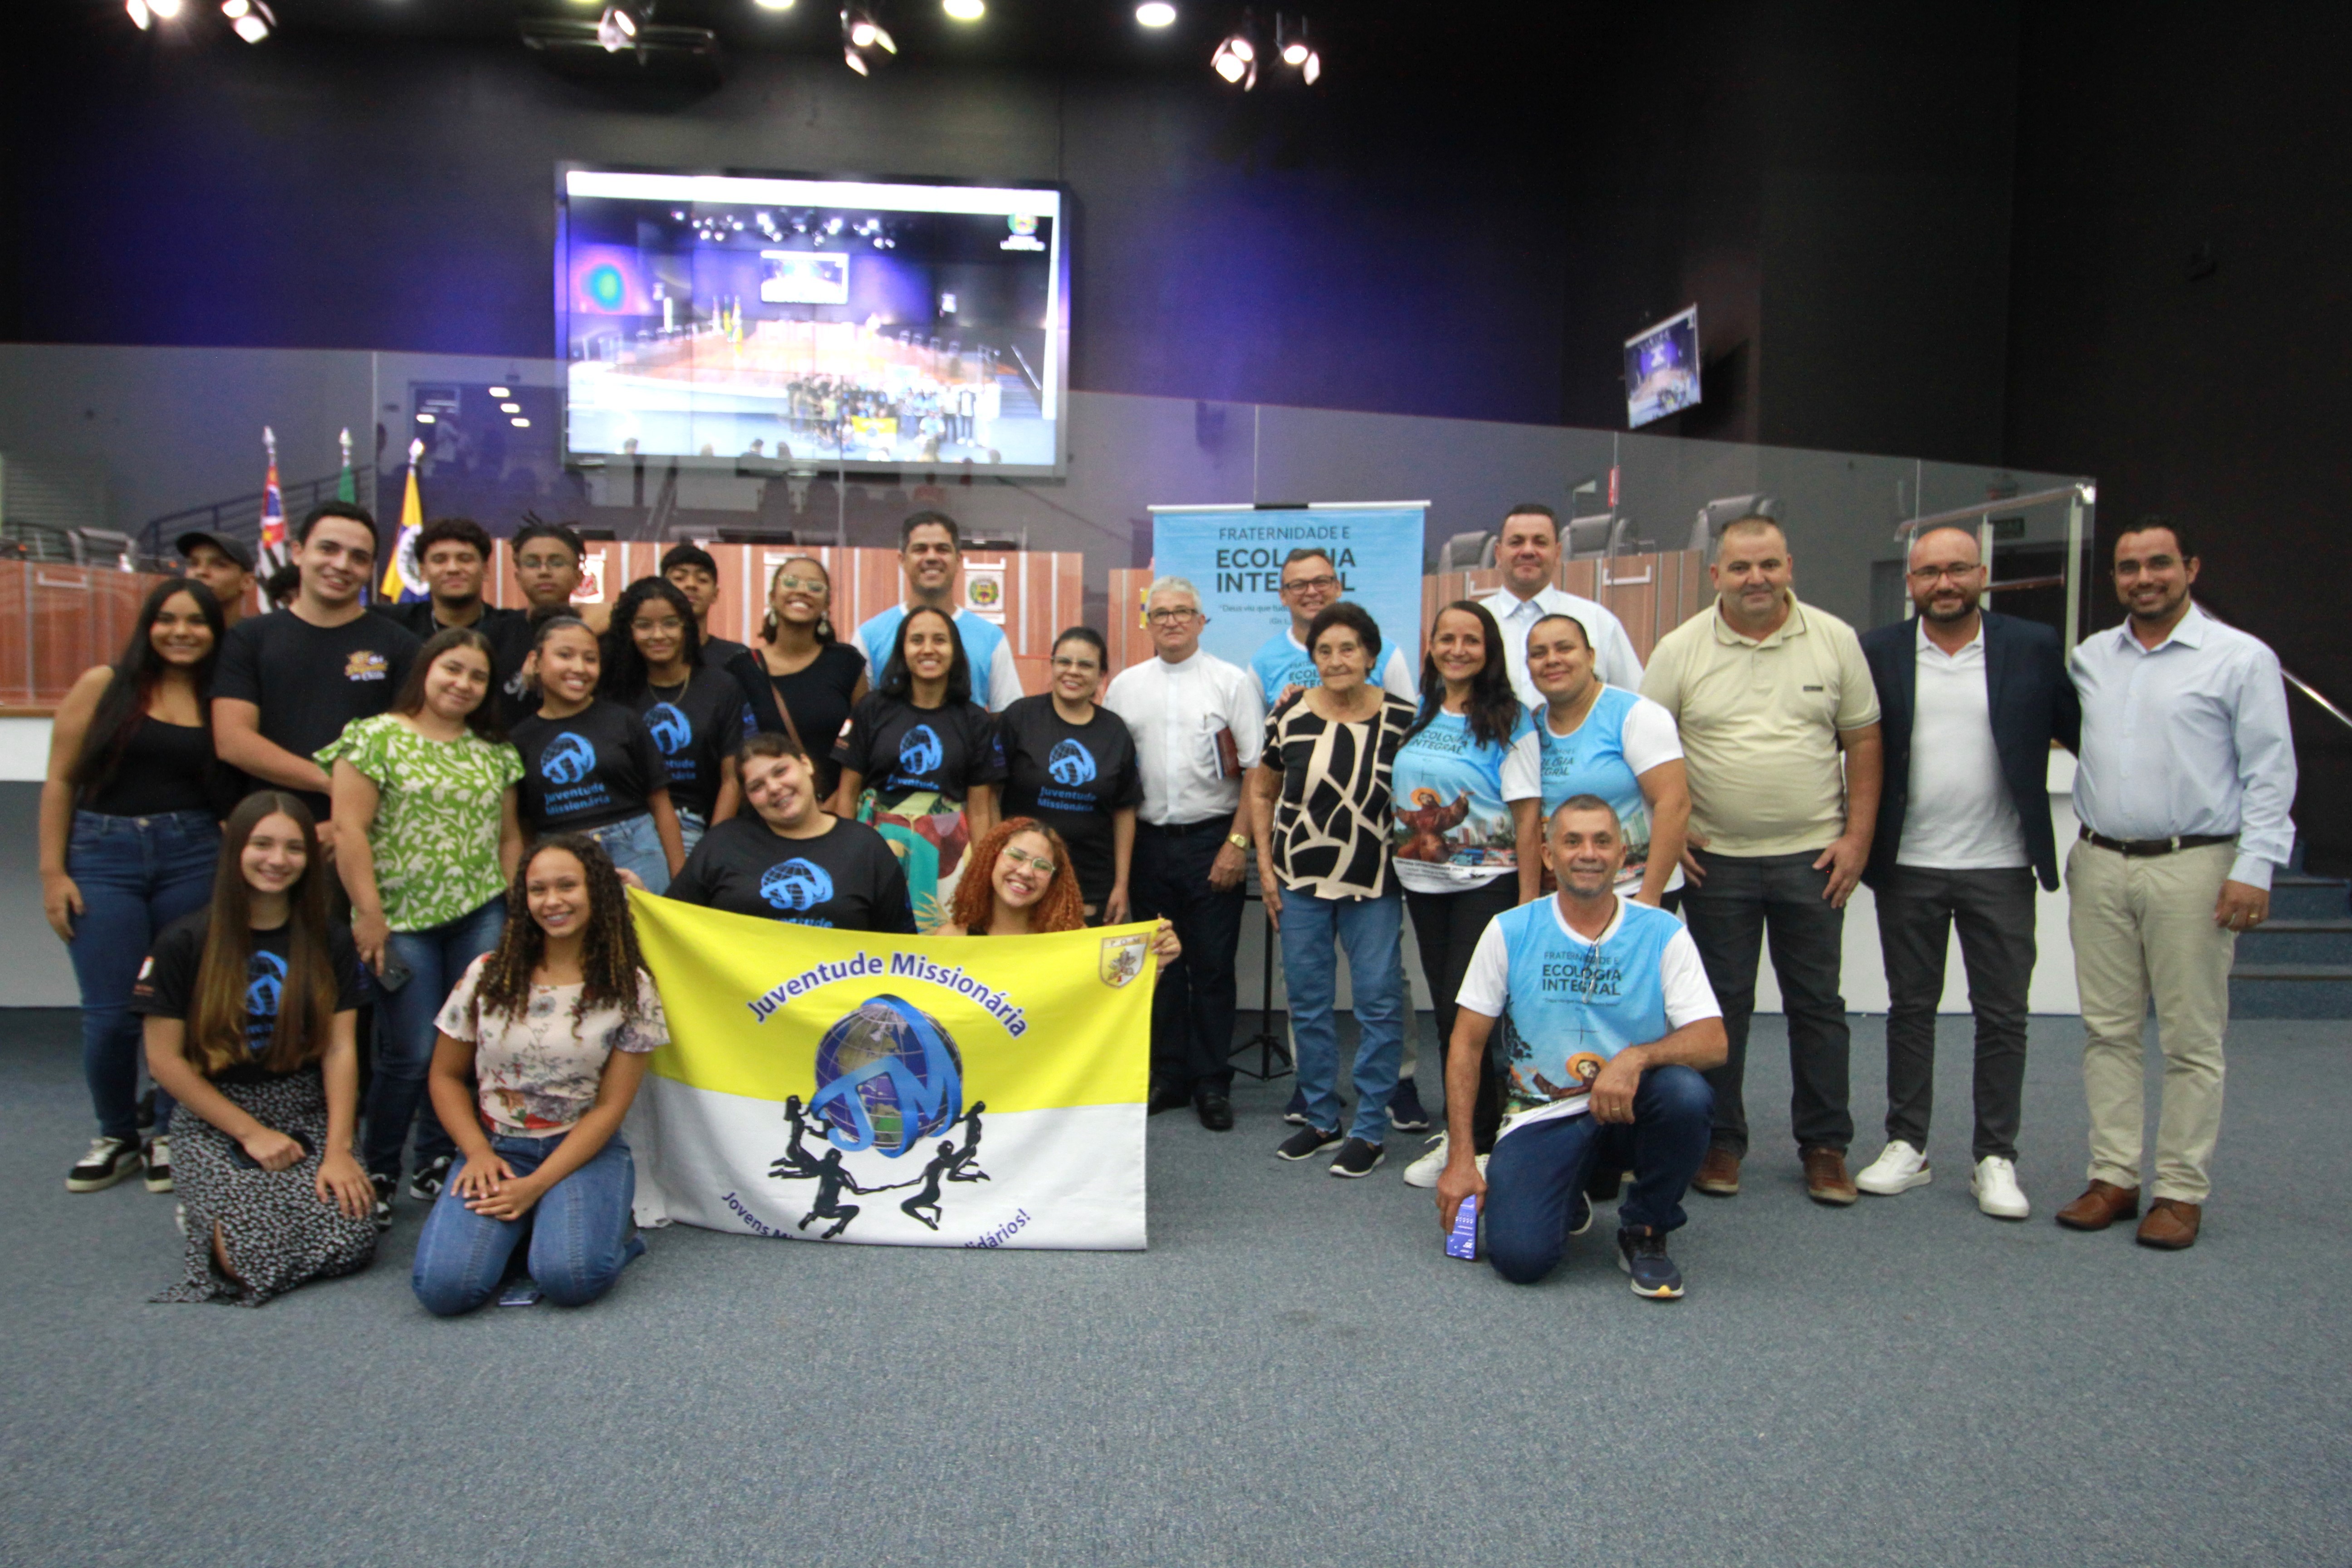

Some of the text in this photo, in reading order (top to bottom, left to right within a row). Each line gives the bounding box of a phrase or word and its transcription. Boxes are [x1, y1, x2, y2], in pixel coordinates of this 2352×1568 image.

[1219, 525, 1350, 540] FRATERNIDADE E
[1216, 548, 1356, 568] ECOLIA
[1217, 572, 1355, 593] INTEL
[545, 783, 605, 805] Juventude
[1040, 786, 1096, 801] Juventude
[1543, 965, 1621, 981] ECOLOGIA
[747, 952, 1026, 1037] Juventude Missionária
[722, 1192, 769, 1236] Jovens
